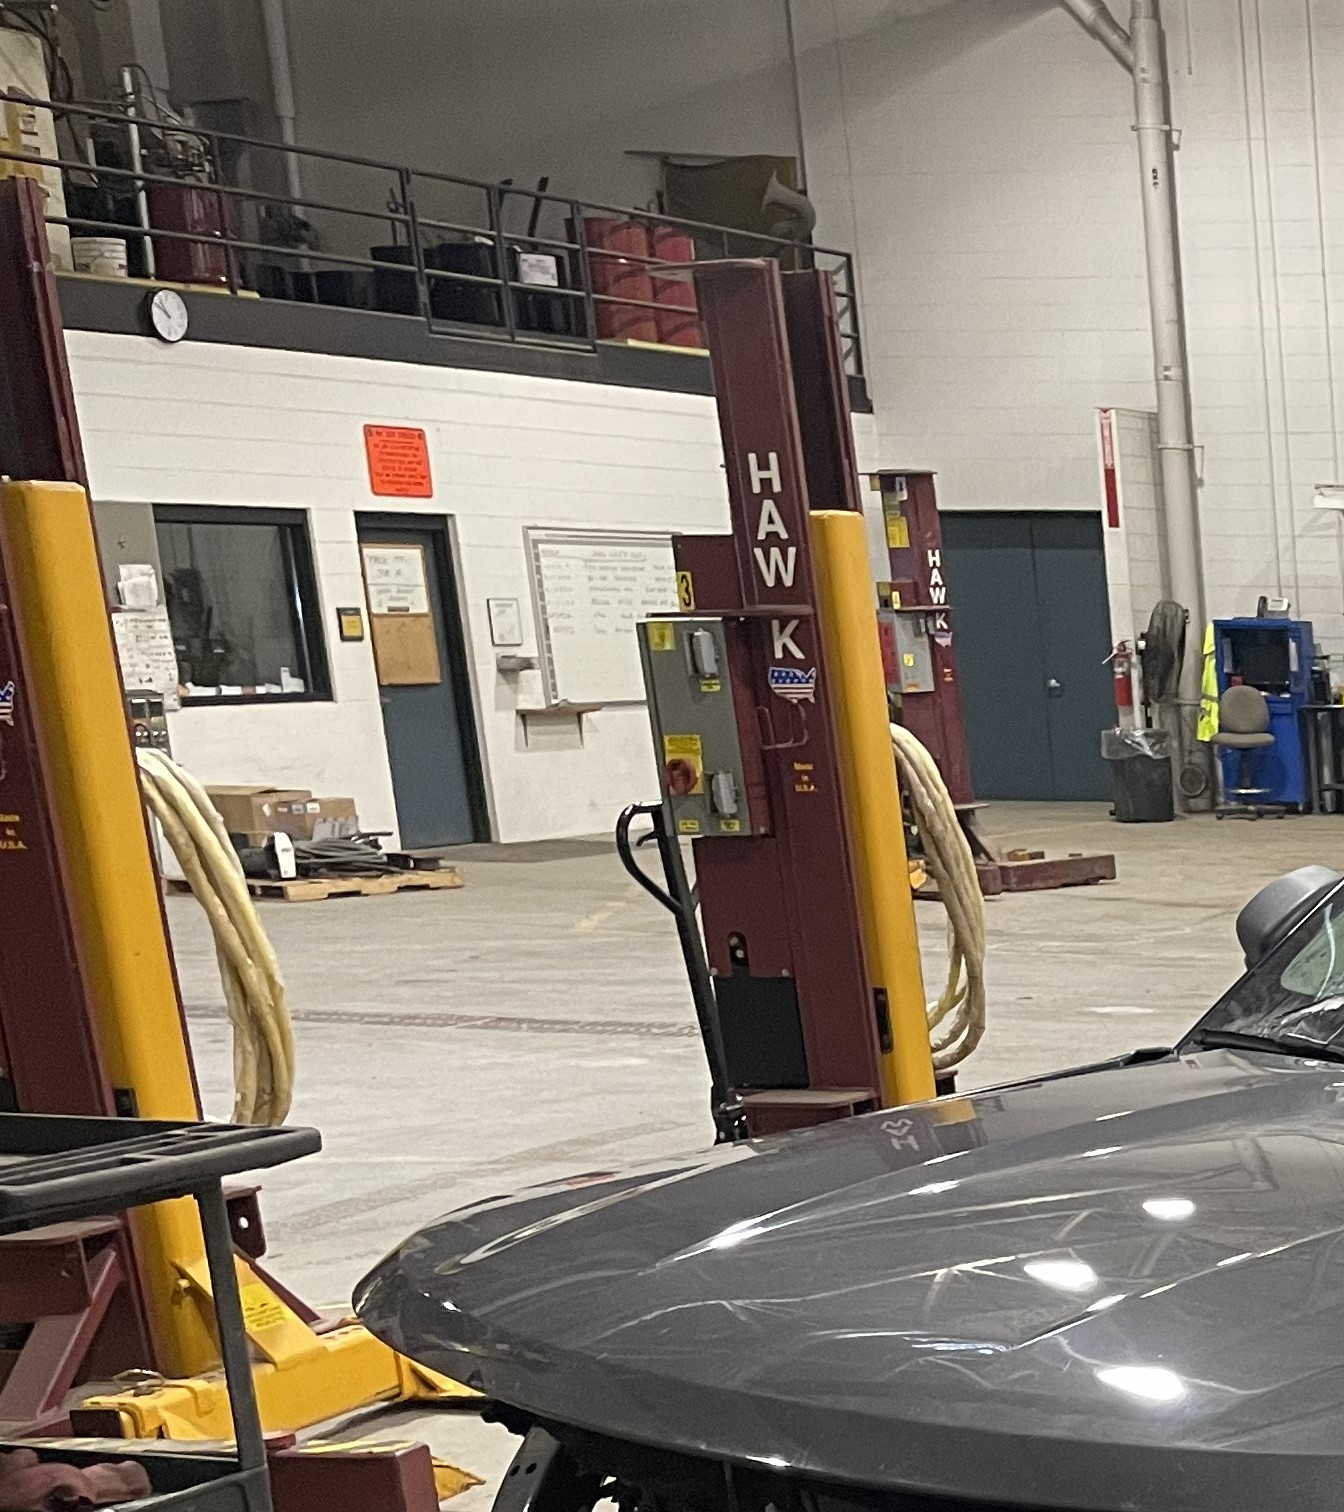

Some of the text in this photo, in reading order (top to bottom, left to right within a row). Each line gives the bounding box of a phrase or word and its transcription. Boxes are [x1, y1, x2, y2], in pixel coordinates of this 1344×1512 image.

[680, 573, 692, 608] 3
[748, 452, 806, 660] HAWK
[927, 549, 948, 629] HAWK
